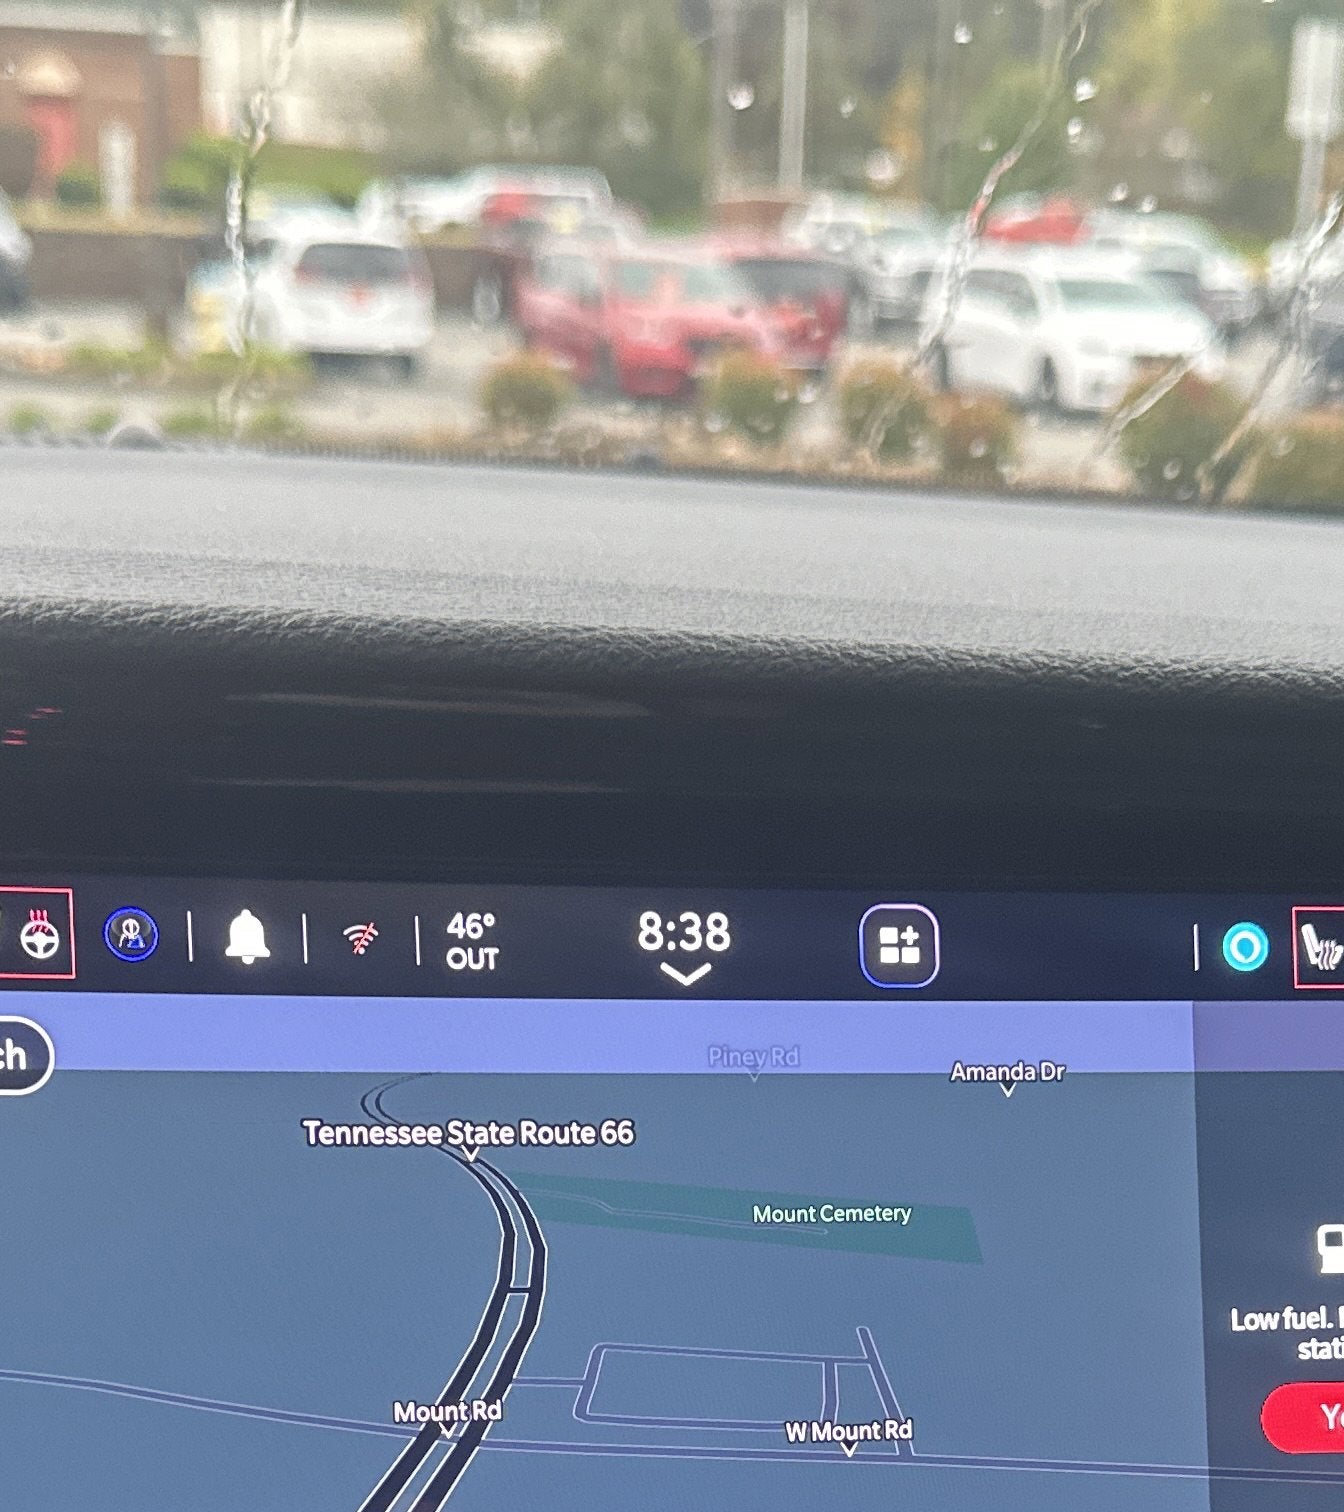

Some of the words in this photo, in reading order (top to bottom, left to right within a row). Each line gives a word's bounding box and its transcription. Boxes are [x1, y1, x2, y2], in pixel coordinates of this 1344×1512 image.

[637, 911, 732, 953] 8:38
[447, 946, 499, 971] OUT
[708, 1046, 769, 1070] Piney
[772, 1046, 800, 1067] Rd
[949, 1061, 1035, 1083] Amanda
[1040, 1061, 1066, 1082] Dr
[303, 1119, 443, 1146] Tennessee
[447, 1120, 516, 1146] State
[520, 1120, 597, 1146] Route
[601, 1119, 635, 1145] 66
[752, 1203, 816, 1224] Mount
[819, 1203, 913, 1228] Cemetery
[1230, 1306, 1279, 1332] Low
[1282, 1305, 1334, 1332] fuel.
[393, 1400, 468, 1426] Mount
[470, 1400, 503, 1424] Rd
[785, 1421, 810, 1442] W
[813, 1420, 882, 1441] Mount
[885, 1418, 913, 1440] Rd
